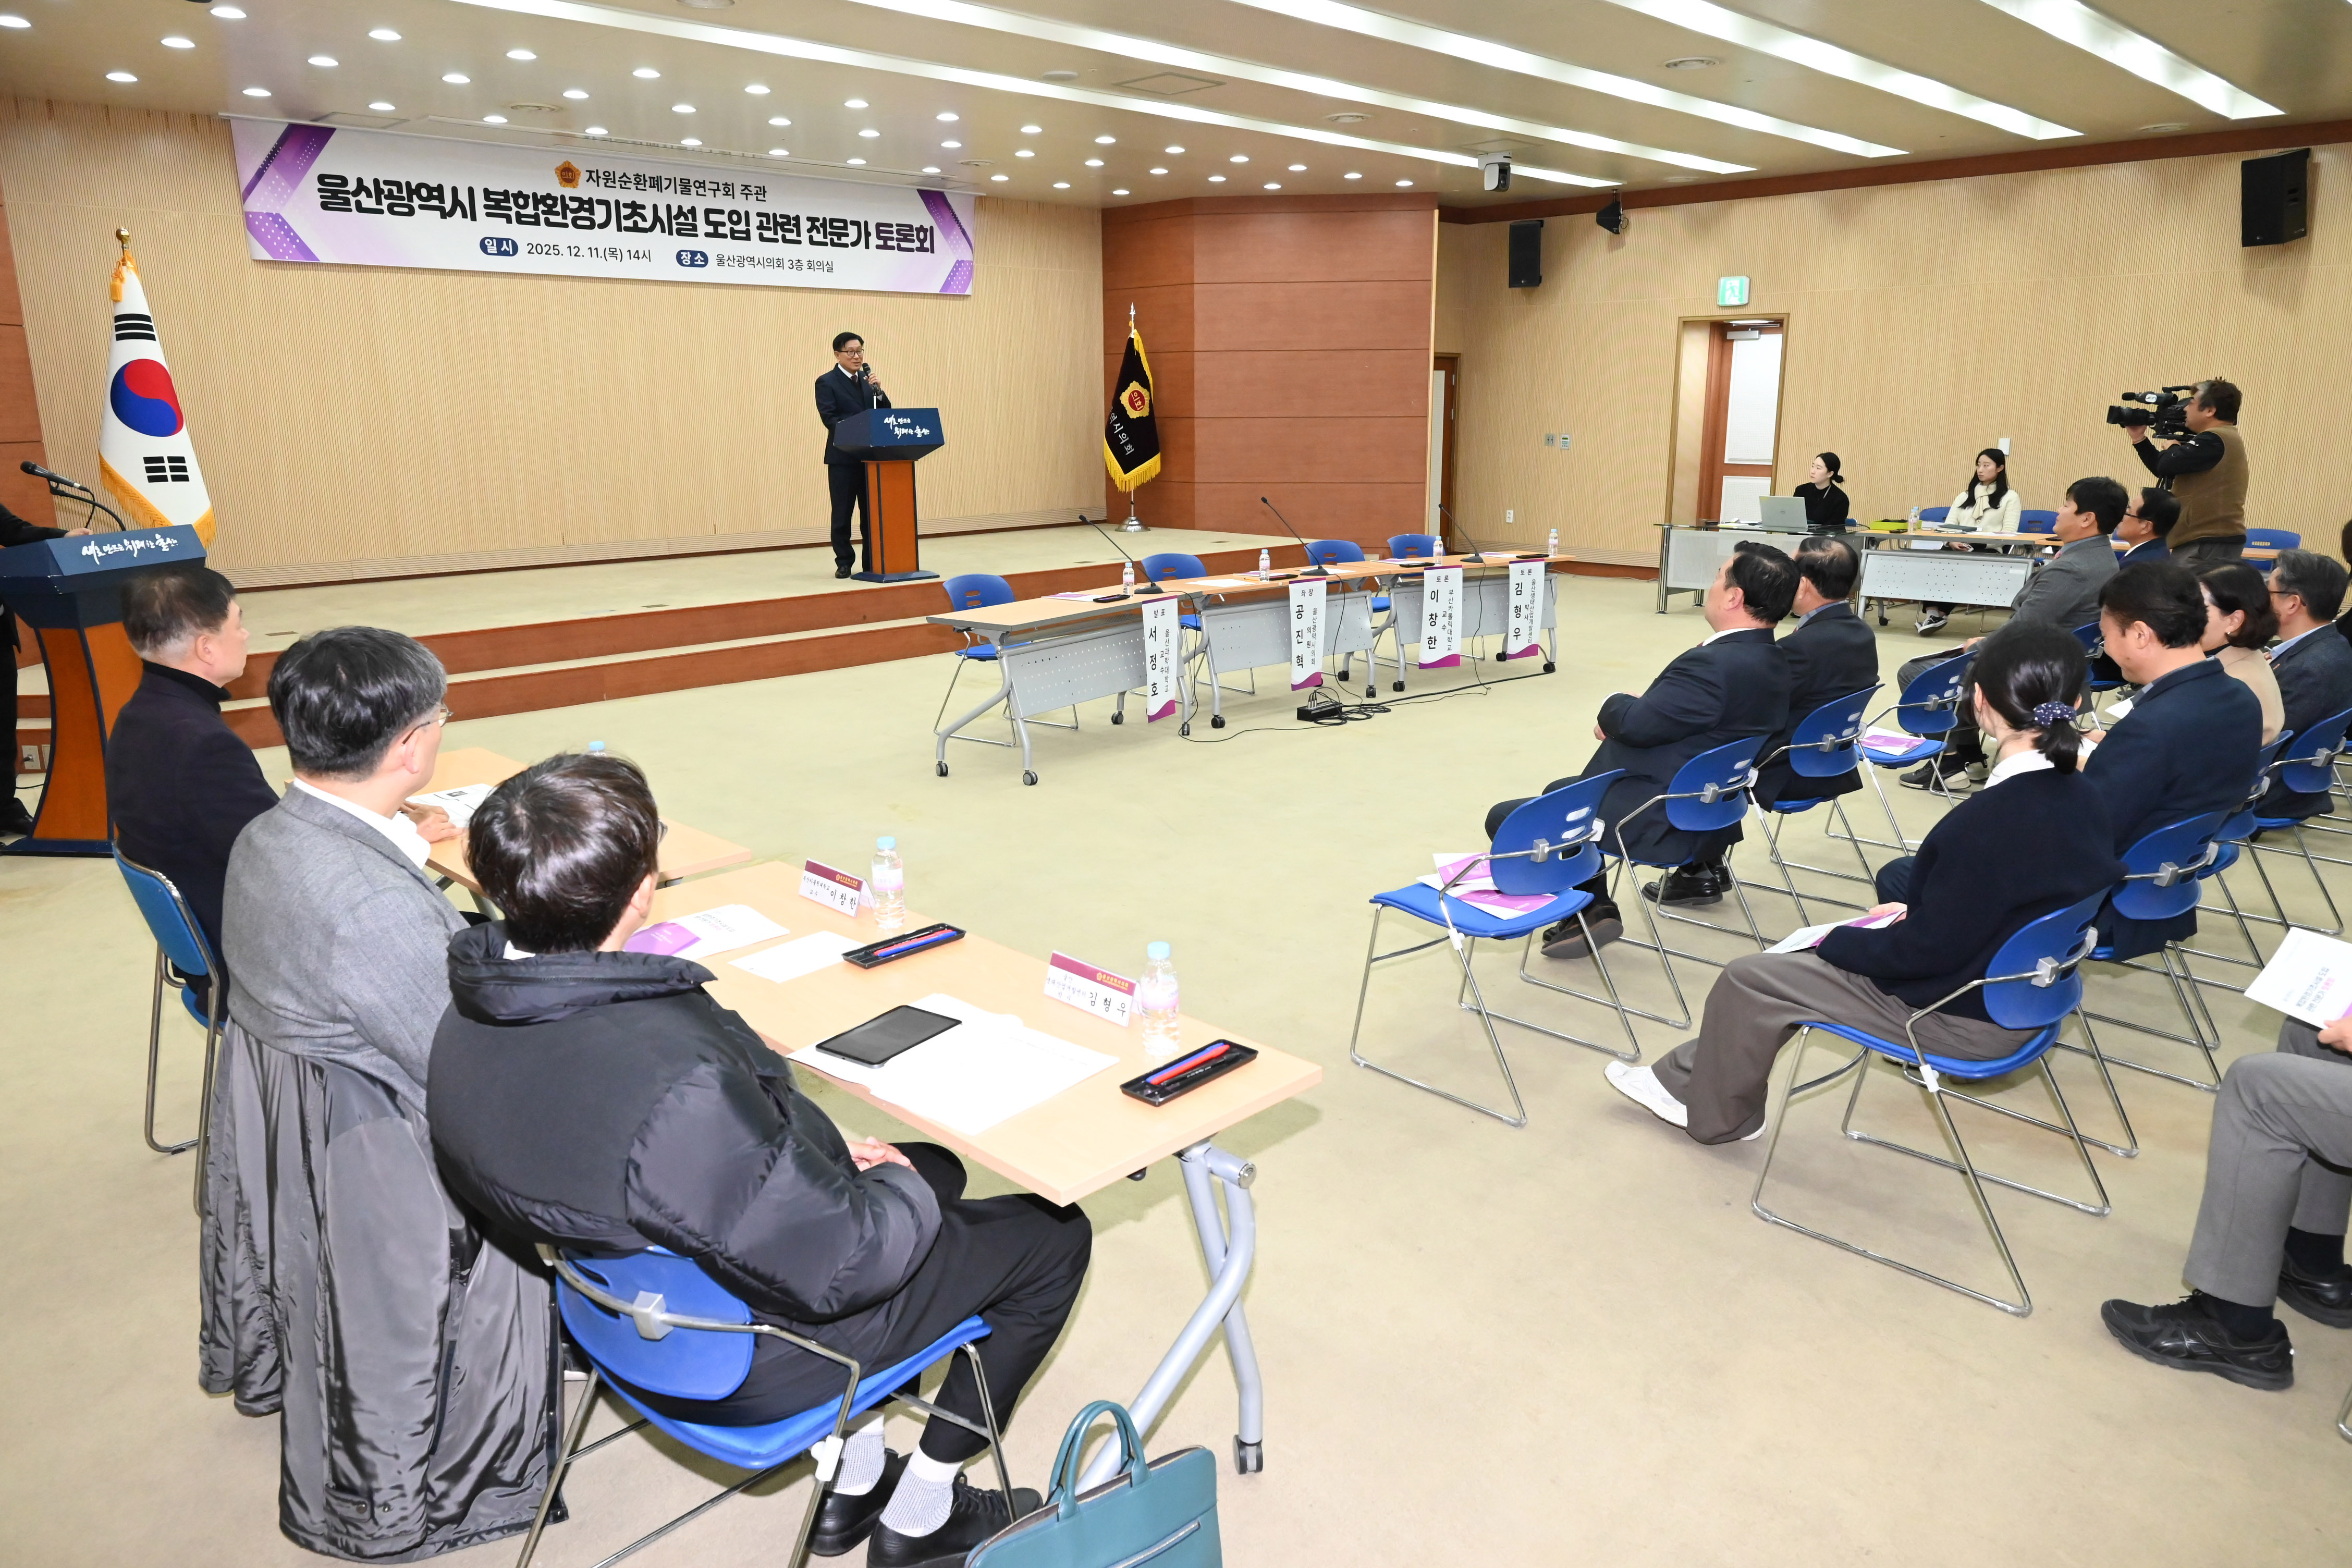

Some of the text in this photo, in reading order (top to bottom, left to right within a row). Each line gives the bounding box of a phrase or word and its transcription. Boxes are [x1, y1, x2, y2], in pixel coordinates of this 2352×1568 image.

[586, 168, 767, 202] 자원순환폐기물연구회 주관
[317, 174, 935, 254] 울산광역시 복합환경기초시설 도입 관련 전문가 토론회
[527, 242, 563, 257] 2025.
[567, 246, 585, 258] 12.
[627, 248, 651, 263] 14시
[716, 254, 785, 271] 울산광역시의회
[788, 259, 803, 272] 3층
[806, 259, 834, 273] 회의실
[1131, 391, 1144, 410] 의회
[914, 425, 929, 437] 울산
[155, 533, 178, 551] 울산
